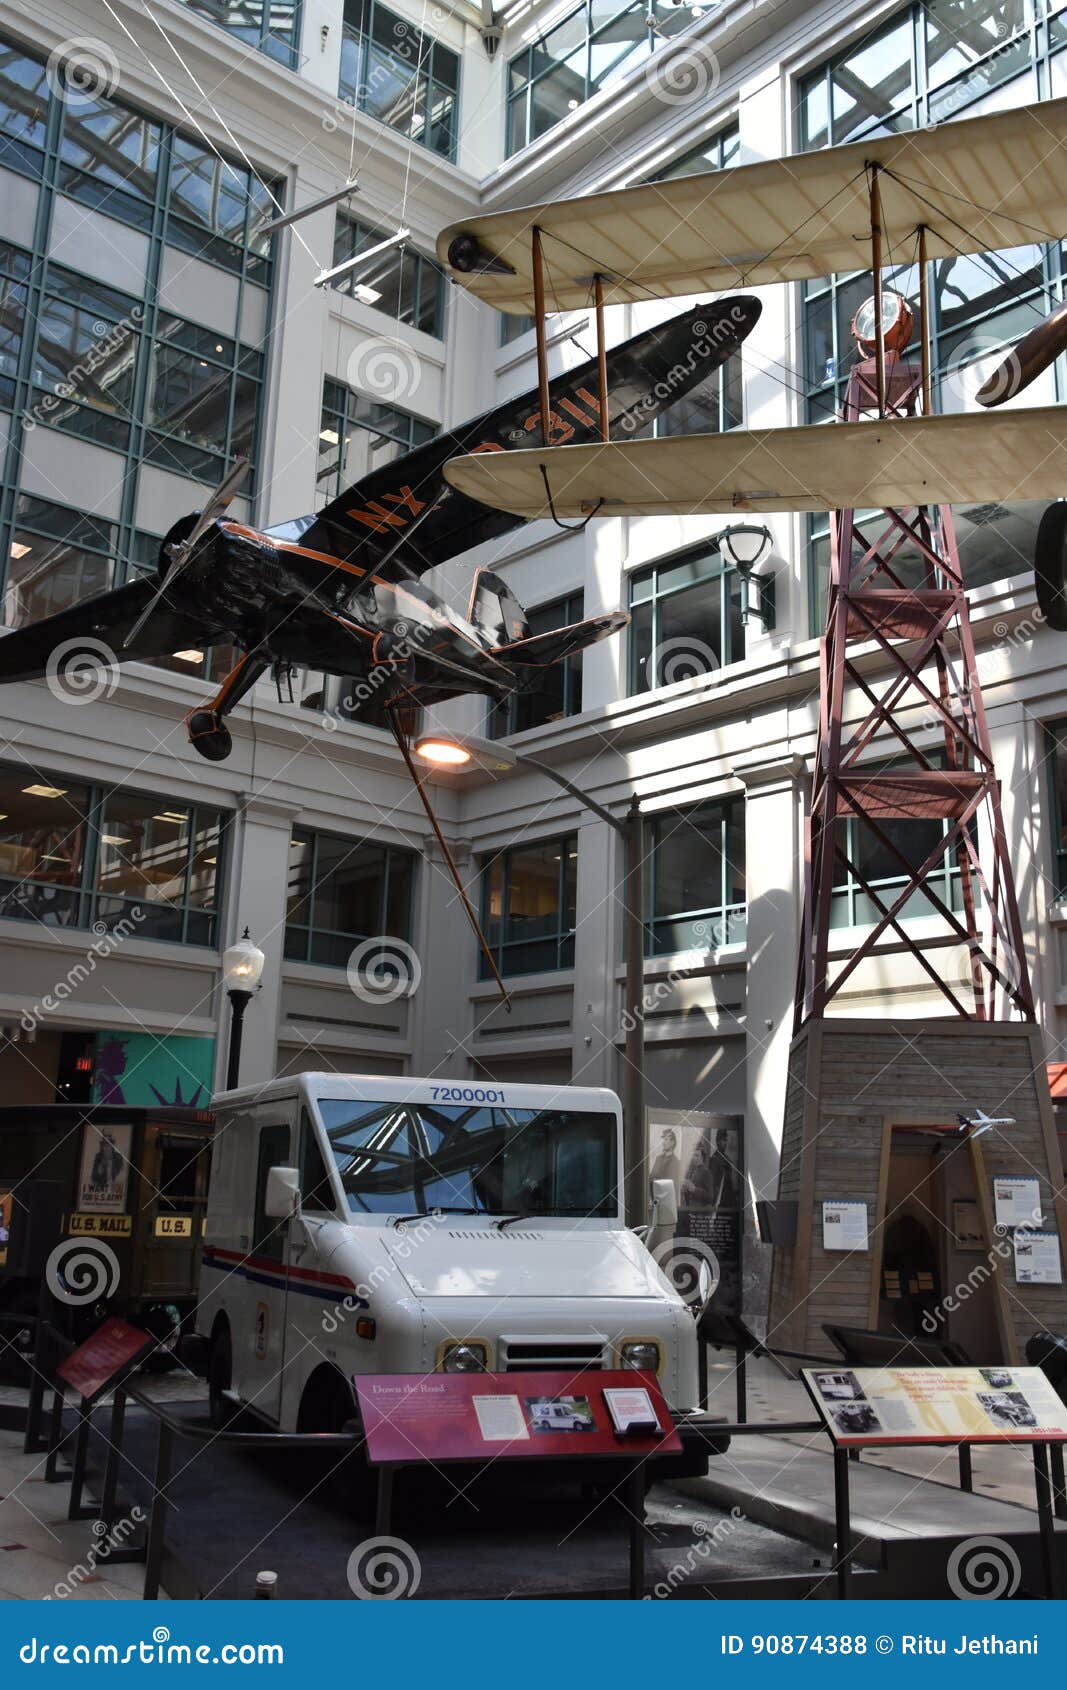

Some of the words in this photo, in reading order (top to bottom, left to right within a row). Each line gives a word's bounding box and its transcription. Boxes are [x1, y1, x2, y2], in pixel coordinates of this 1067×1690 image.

[346, 485, 426, 534] NX
[430, 1086, 505, 1103] 7200001
[71, 1218, 96, 1231] U.S.
[98, 1217, 130, 1232] MAIL
[161, 1220, 186, 1233] U.S.
